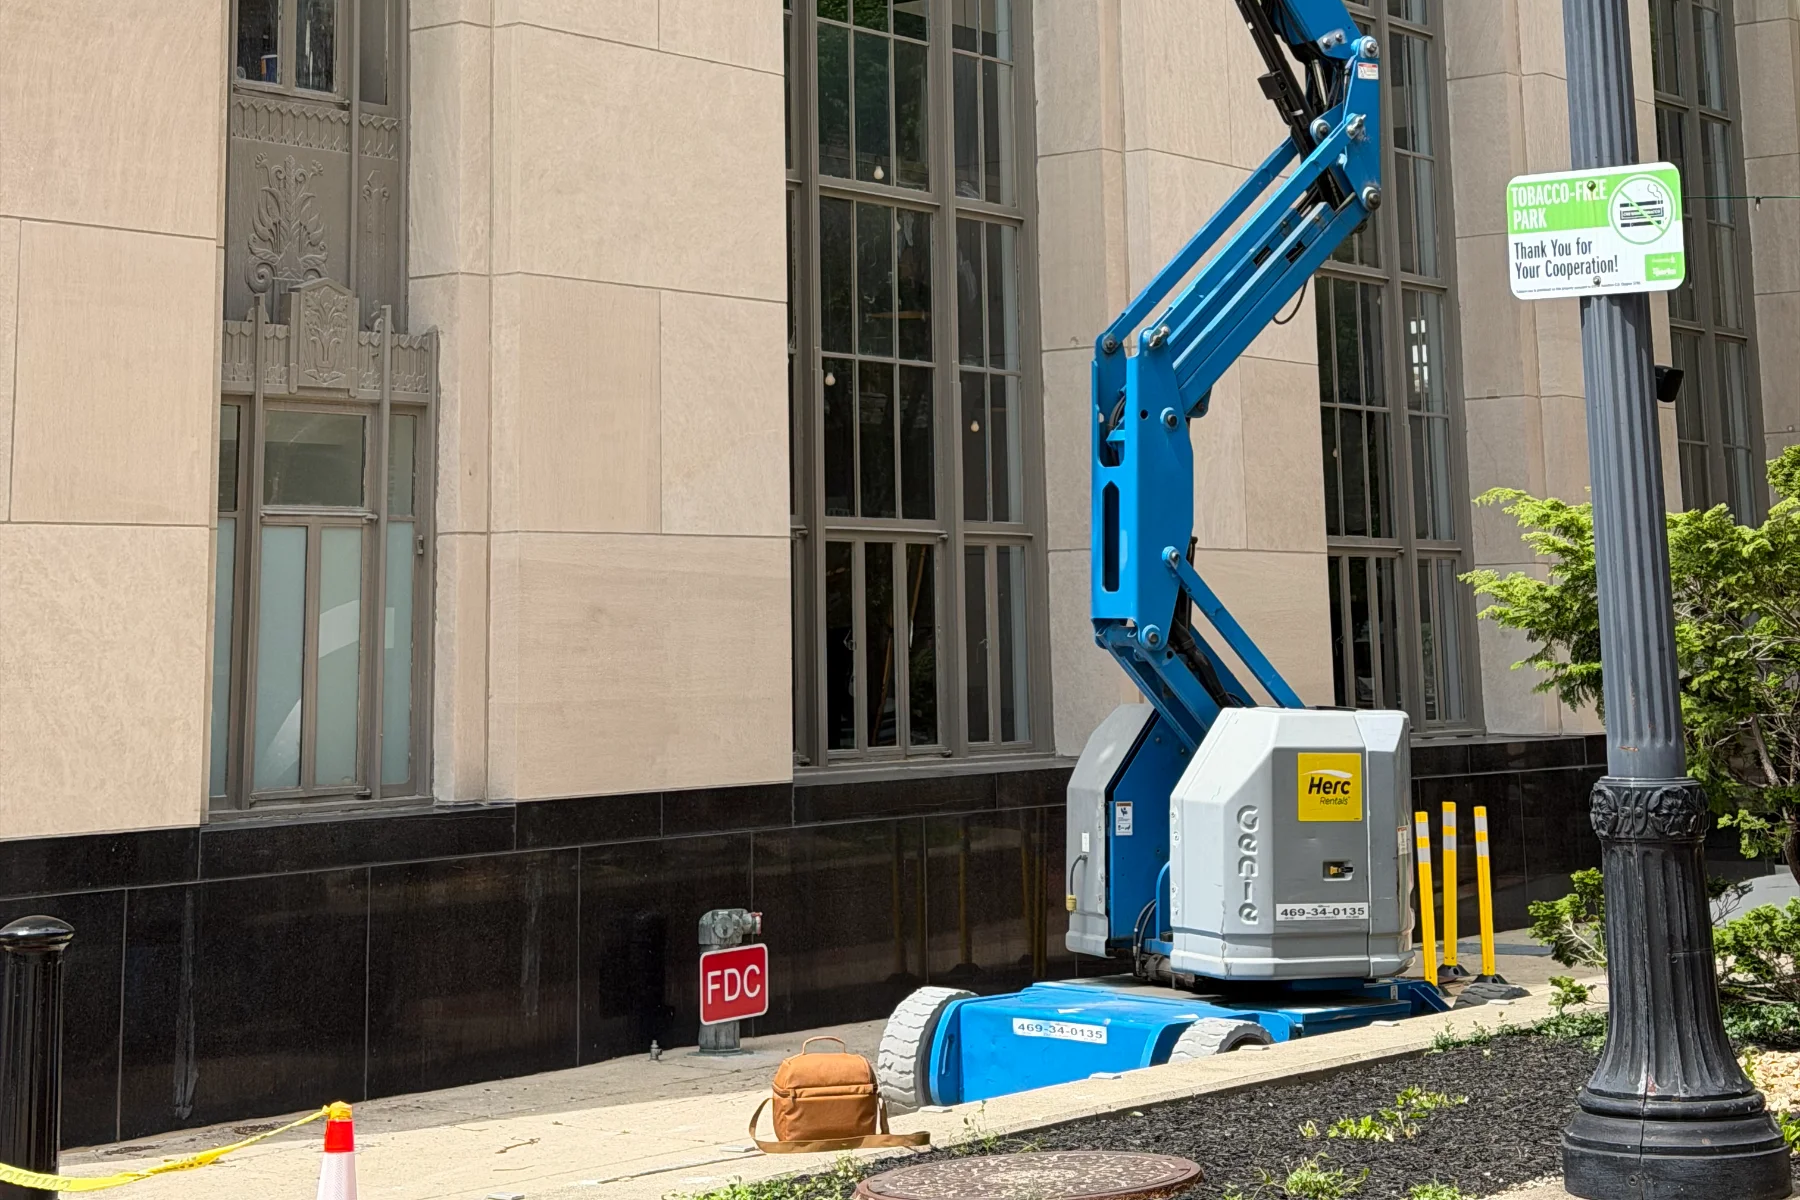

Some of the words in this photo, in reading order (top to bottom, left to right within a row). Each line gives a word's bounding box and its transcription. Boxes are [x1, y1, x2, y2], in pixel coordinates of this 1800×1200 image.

[1513, 208, 1547, 230] PARK
[1514, 240, 1547, 260] Thank
[1551, 238, 1572, 257] You
[1576, 237, 1592, 255] for
[1515, 262, 1541, 279] Your
[1545, 255, 1619, 280] Cooperation!
[1308, 776, 1351, 795] Herc
[1320, 796, 1348, 806] Rentals
[1236, 804, 1259, 926] Genie
[1280, 906, 1365, 917] 469-34-0135
[707, 964, 761, 1005] FDC
[1017, 1023, 1103, 1039] 469-34-0135
